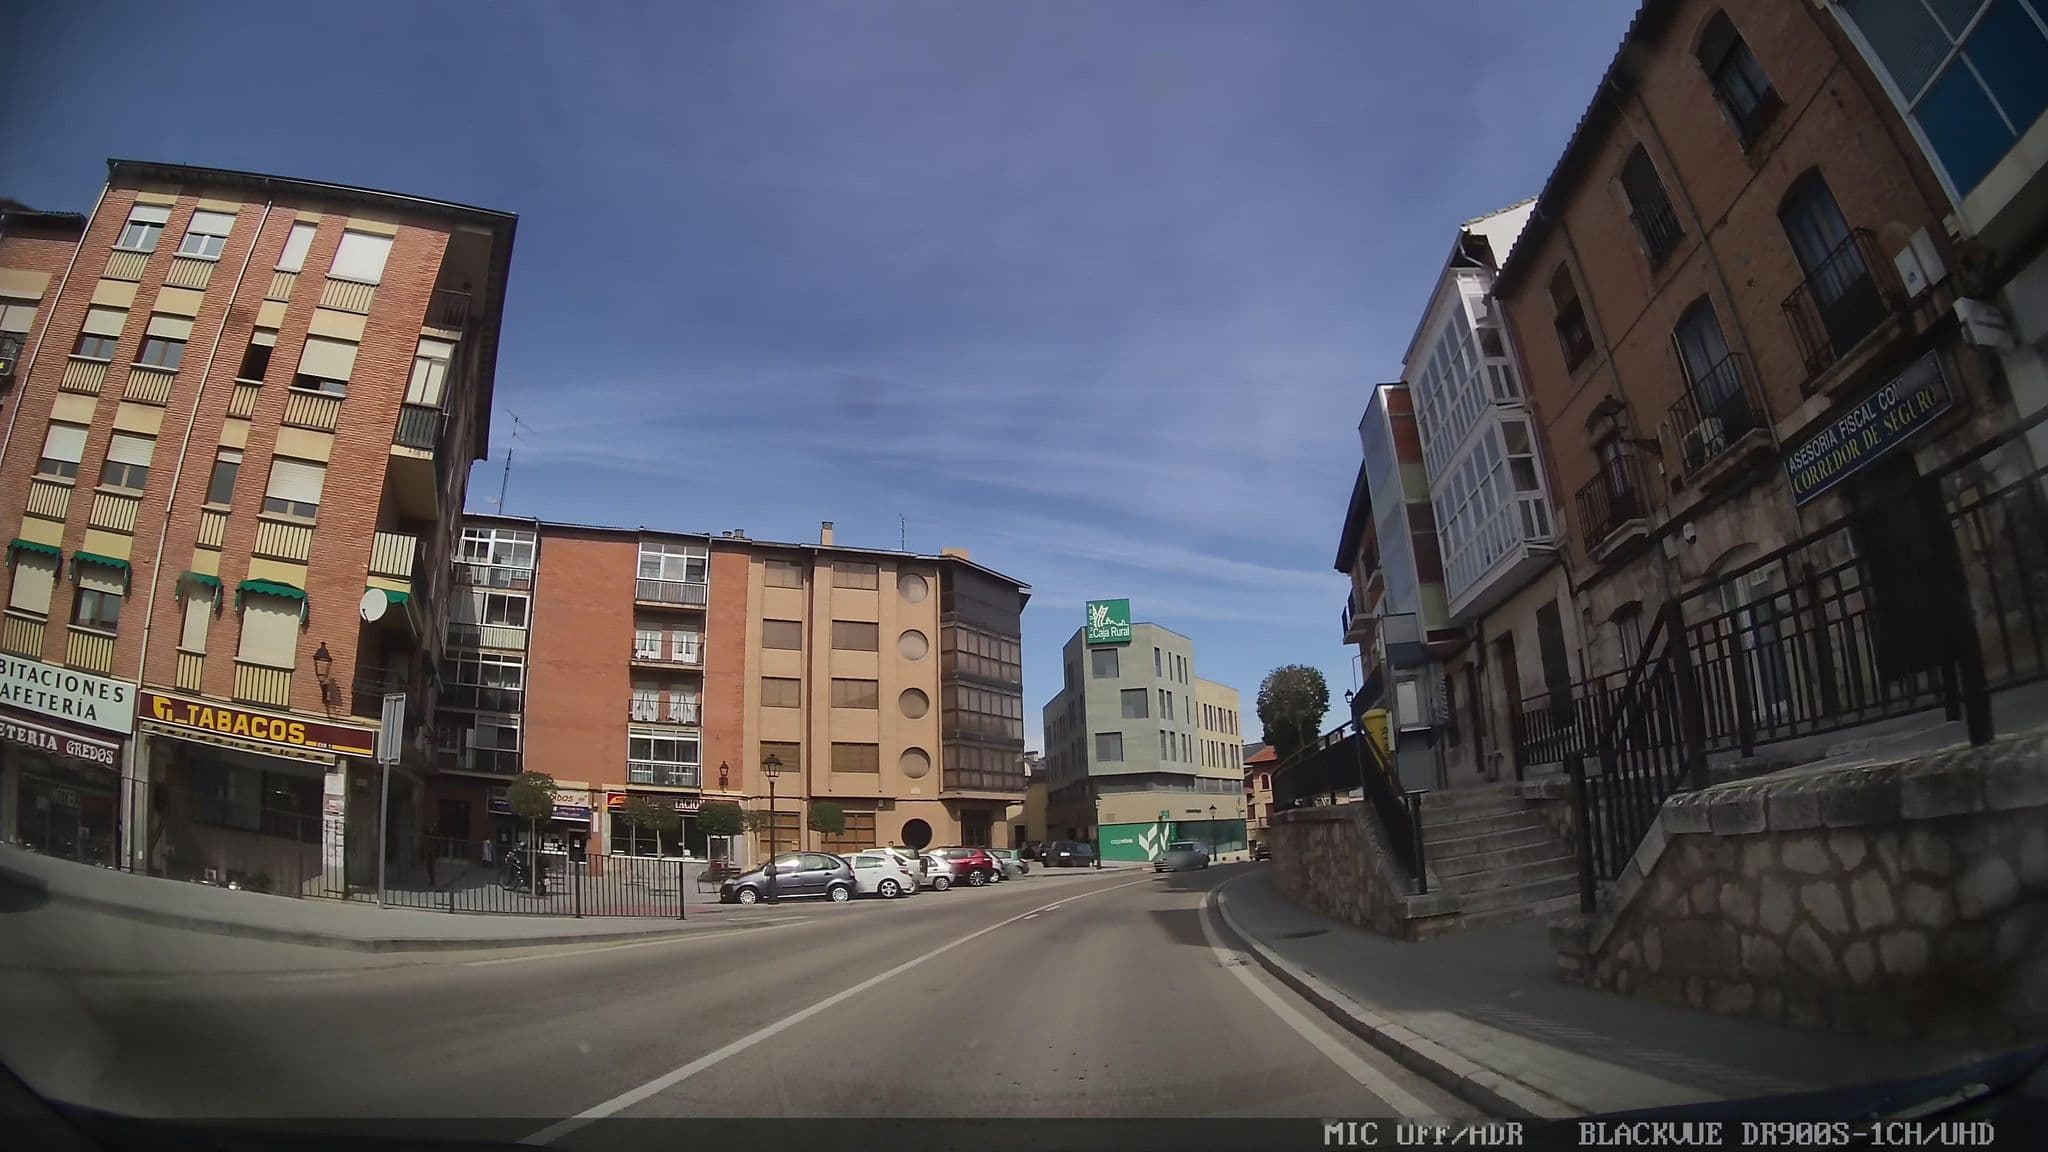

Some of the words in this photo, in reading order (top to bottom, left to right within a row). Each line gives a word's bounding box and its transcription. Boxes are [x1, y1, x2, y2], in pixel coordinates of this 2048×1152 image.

[1789, 429, 1838, 475] ASESORIA
[1838, 402, 1877, 440] FISCAL
[1794, 437, 1861, 494] CORREDOR
[1862, 423, 1882, 450] DE
[1093, 626, 1110, 640] Caja
[1110, 626, 1130, 637] Rural
[0, 682, 97, 721] AFETERÍA
[187, 703, 305, 745] TABACOS
[66, 740, 114, 765] GREDOS
